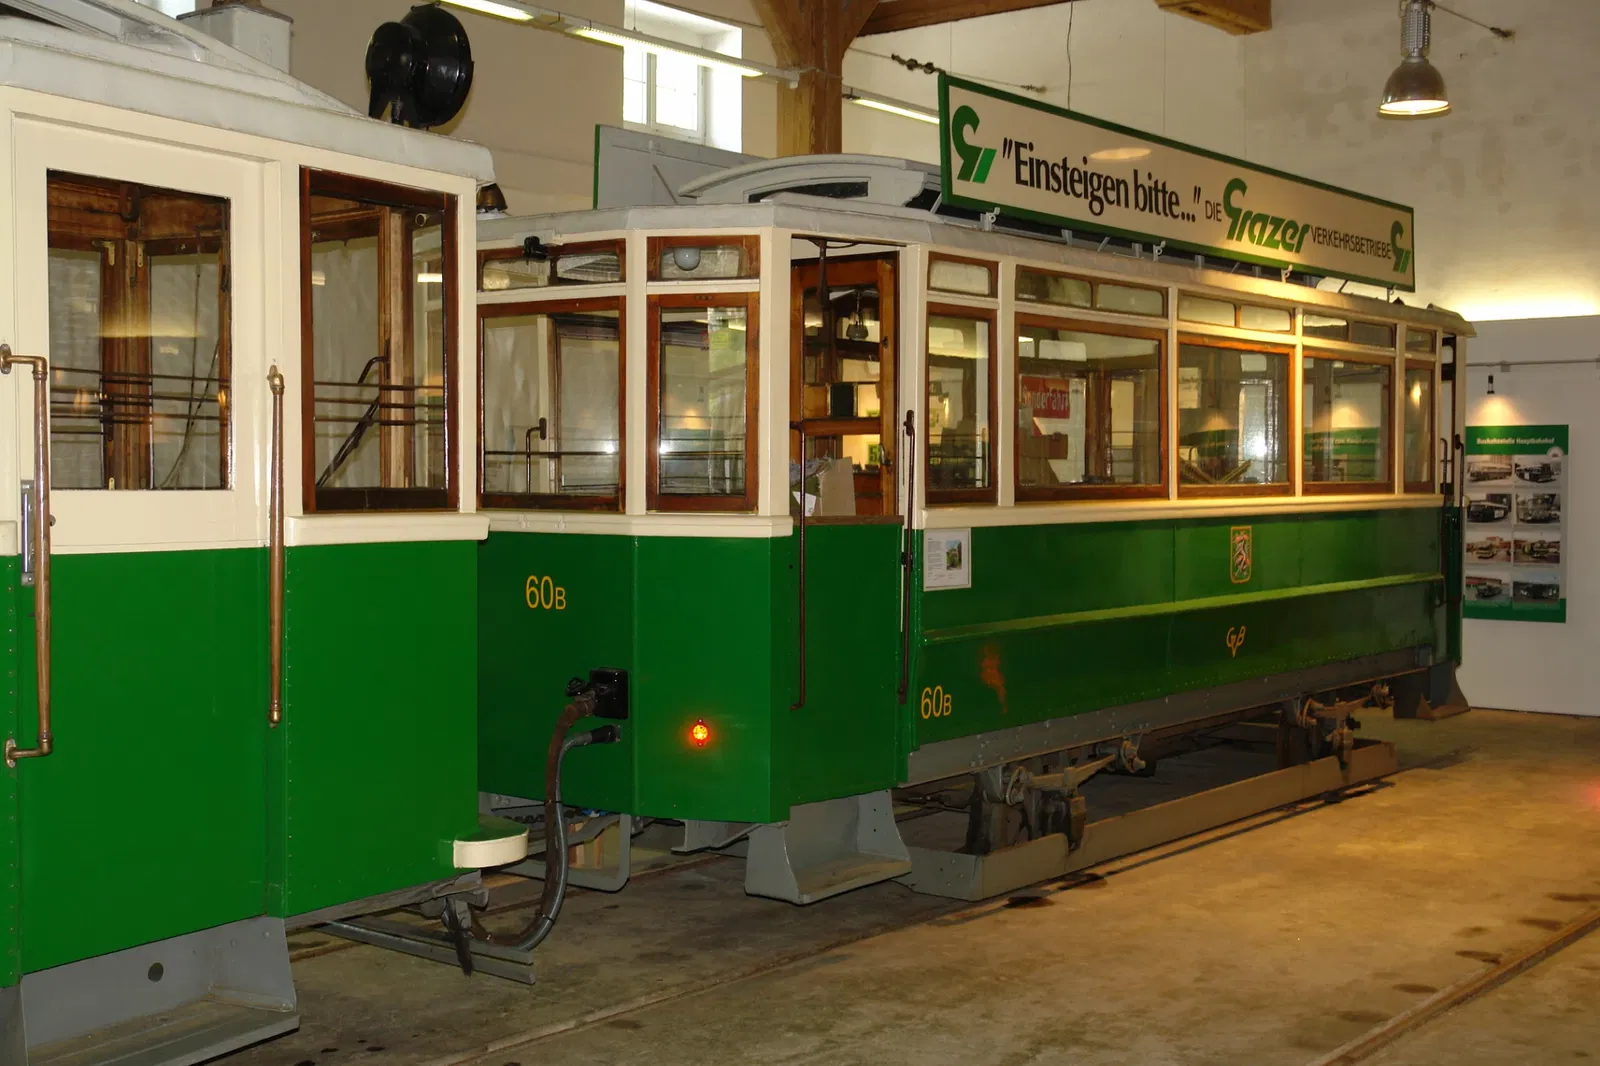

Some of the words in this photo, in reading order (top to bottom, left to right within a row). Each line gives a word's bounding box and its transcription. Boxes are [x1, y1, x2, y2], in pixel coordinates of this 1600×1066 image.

[1002, 136, 1130, 217] "Einsteigen
[1205, 200, 1222, 222] DIE
[1223, 178, 1311, 254] Grazer
[1310, 226, 1392, 260] VERKEHRSBETRIEBE
[525, 574, 567, 610] 60B
[920, 685, 953, 720] 60B
